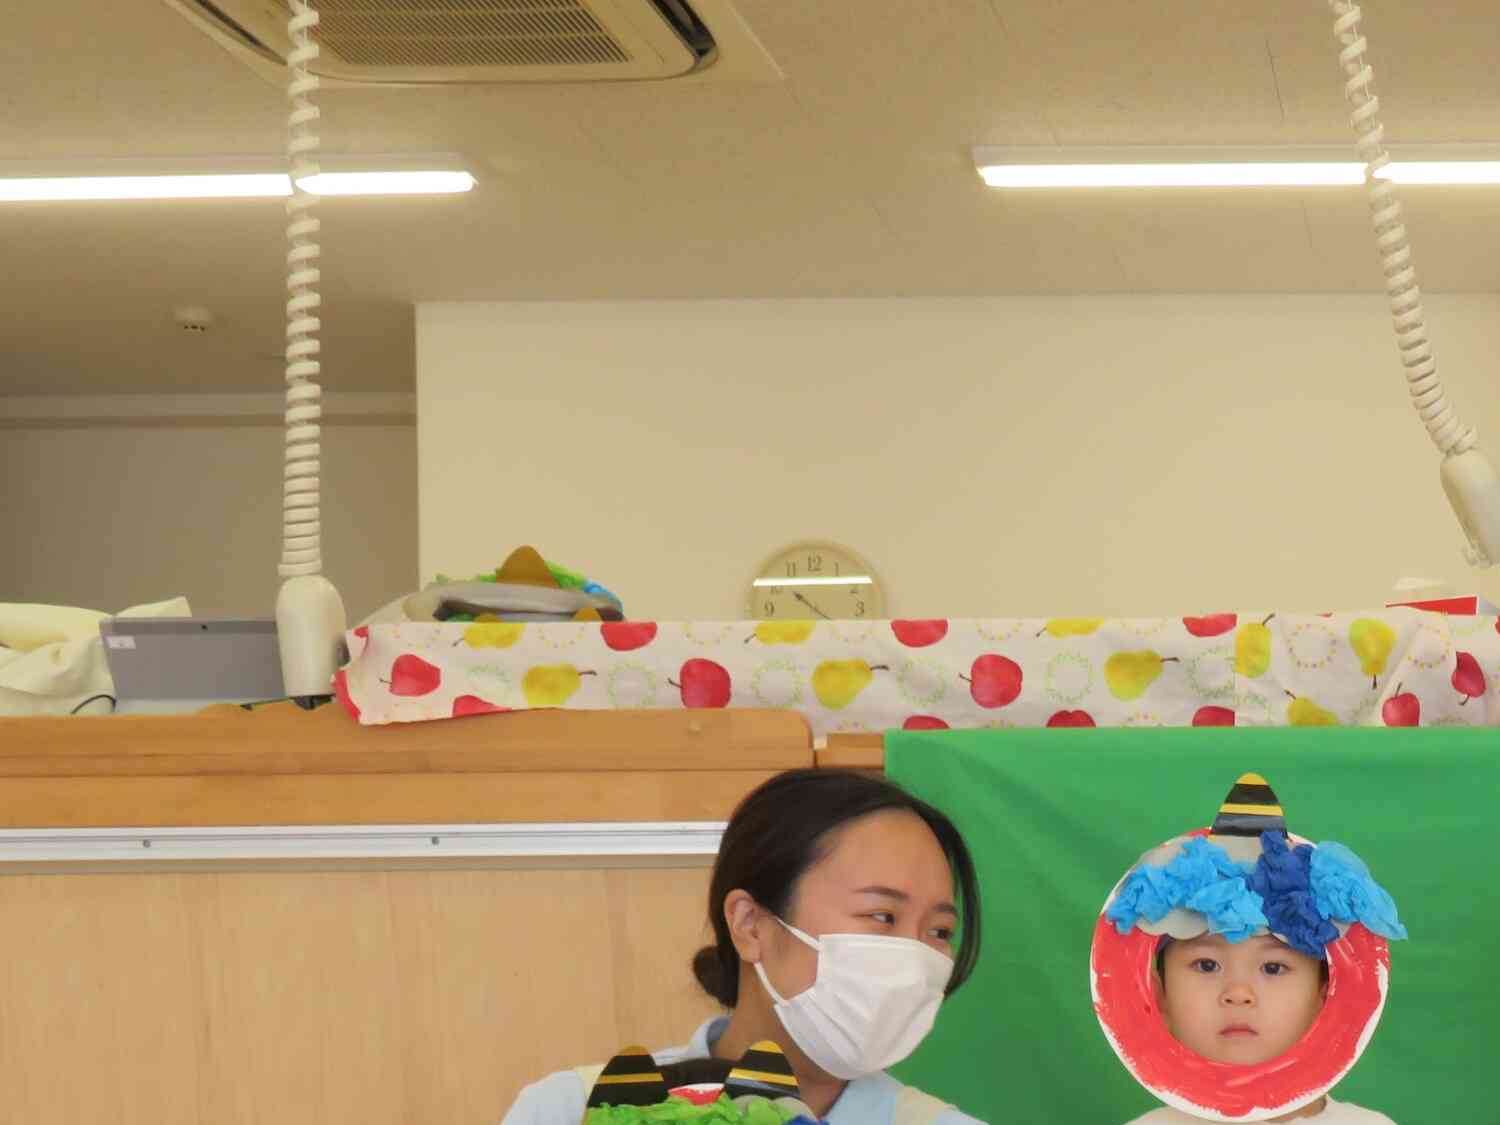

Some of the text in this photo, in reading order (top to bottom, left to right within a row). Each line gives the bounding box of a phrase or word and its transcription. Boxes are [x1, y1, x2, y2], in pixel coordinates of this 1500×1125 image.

[807, 553, 823, 572] 12
[763, 600, 775, 617] 9
[854, 600, 865, 617] 3
